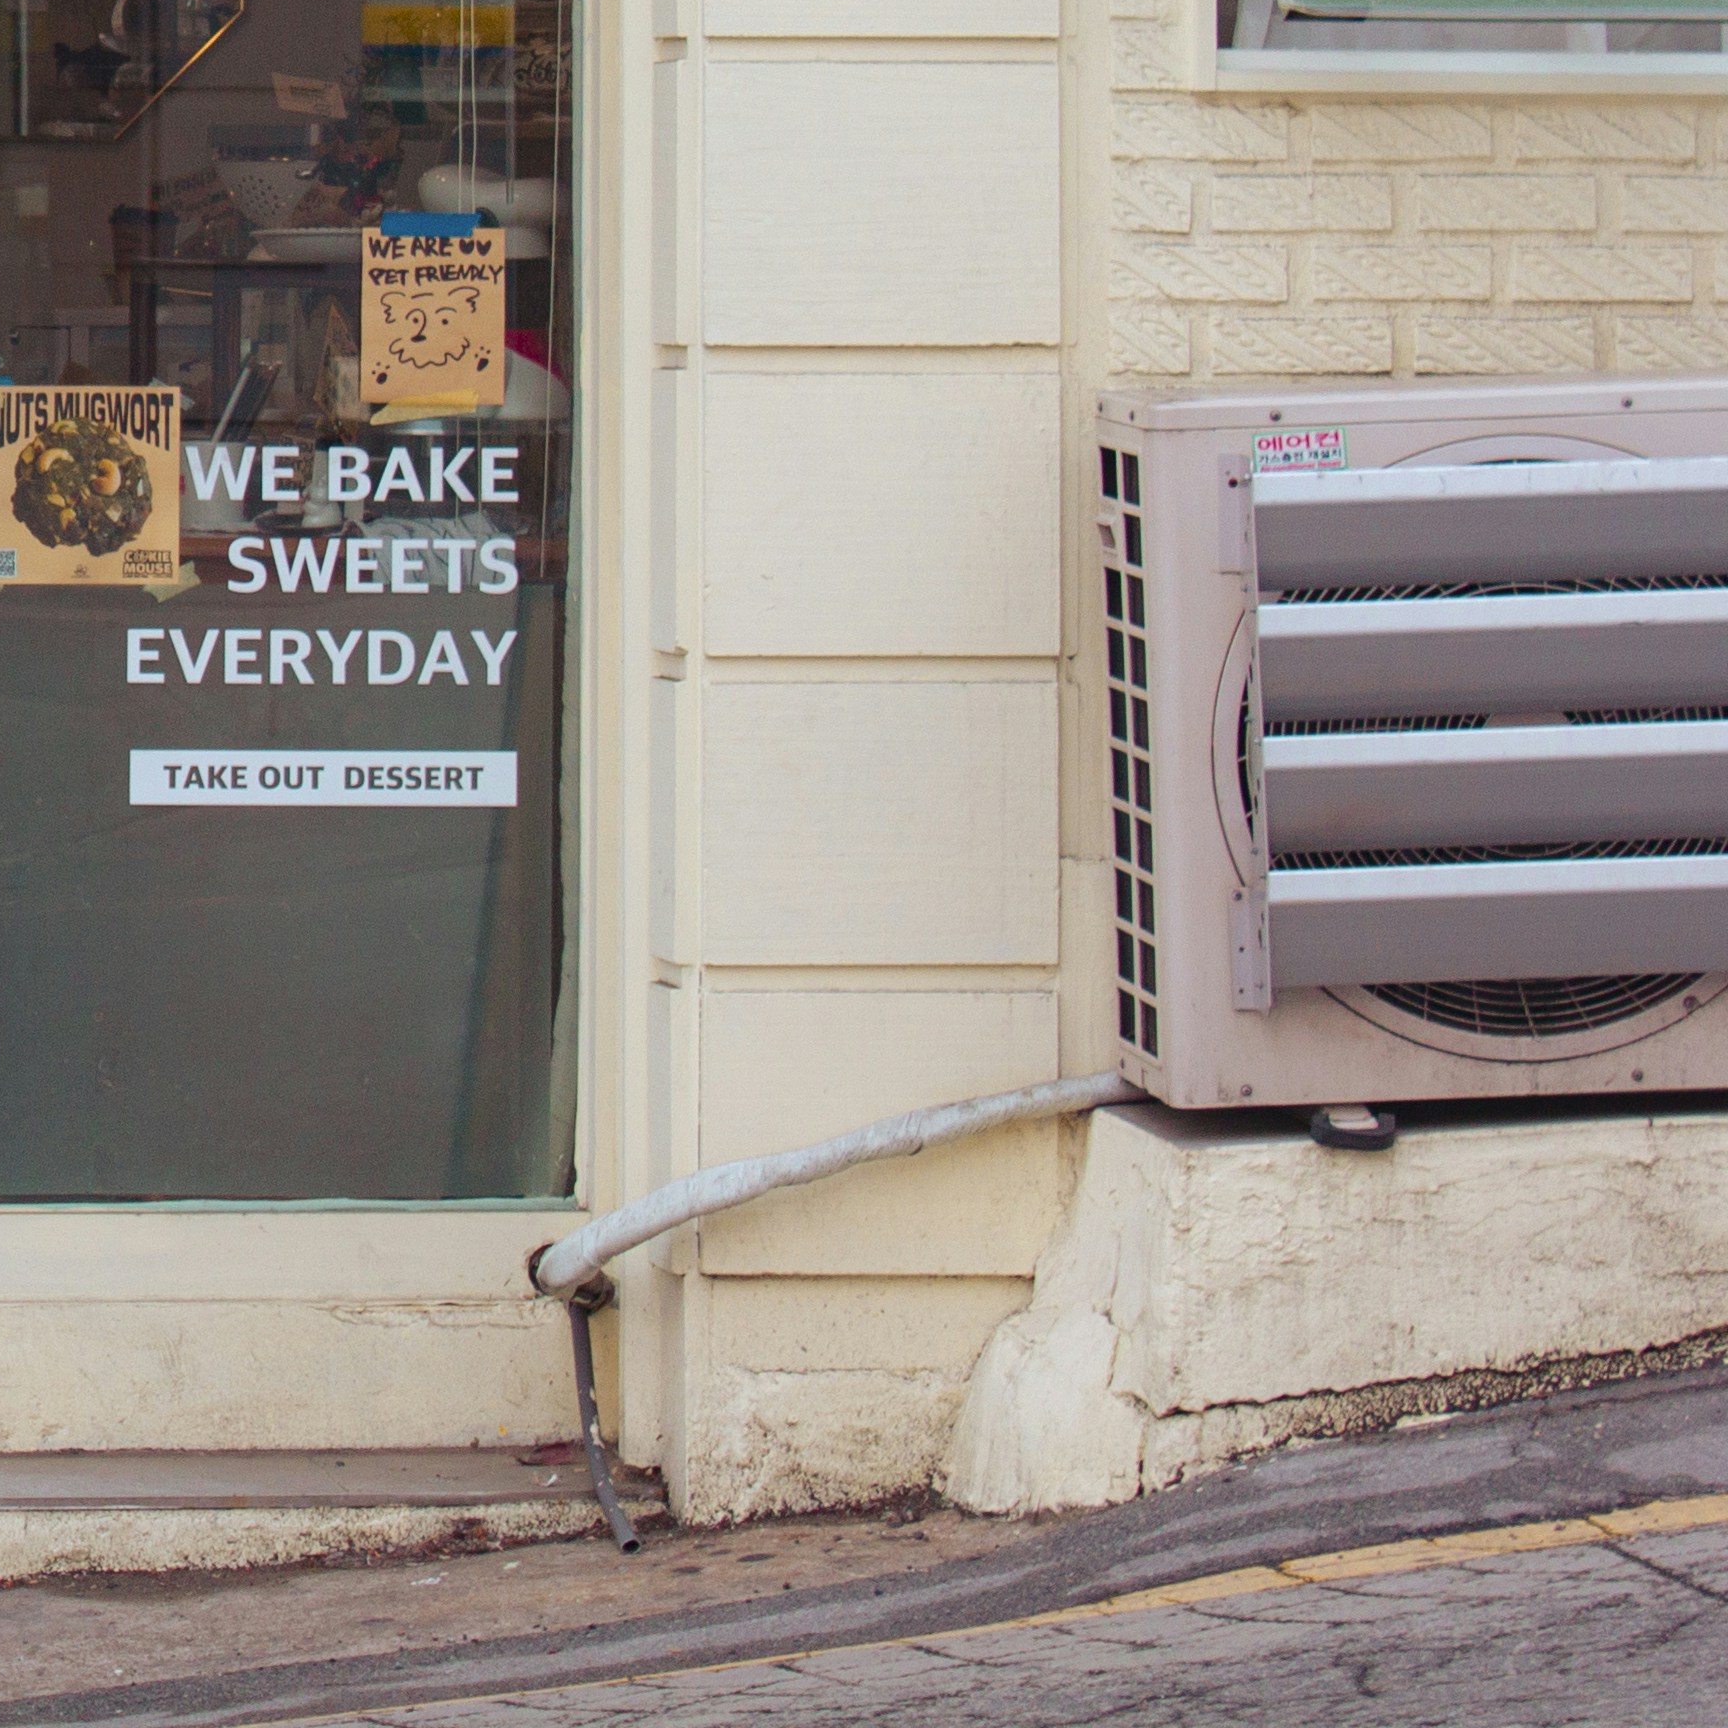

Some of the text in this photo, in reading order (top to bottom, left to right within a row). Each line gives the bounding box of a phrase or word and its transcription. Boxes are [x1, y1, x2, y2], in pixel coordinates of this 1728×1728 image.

[369, 236, 453, 259] WE ARE
[369, 265, 504, 286] PET FRIENDLY
[55, 393, 174, 452] MUGWORT
[1257, 430, 1339, 451] 에어컨
[183, 447, 300, 501] WE
[327, 447, 519, 502] BAKE
[123, 562, 173, 575] MOUSE
[124, 550, 172, 563] COOKIE
[227, 538, 519, 594] SWEETS
[127, 628, 517, 685] EVERYDAY
[163, 764, 484, 790] TAKE OUT DESSERT
